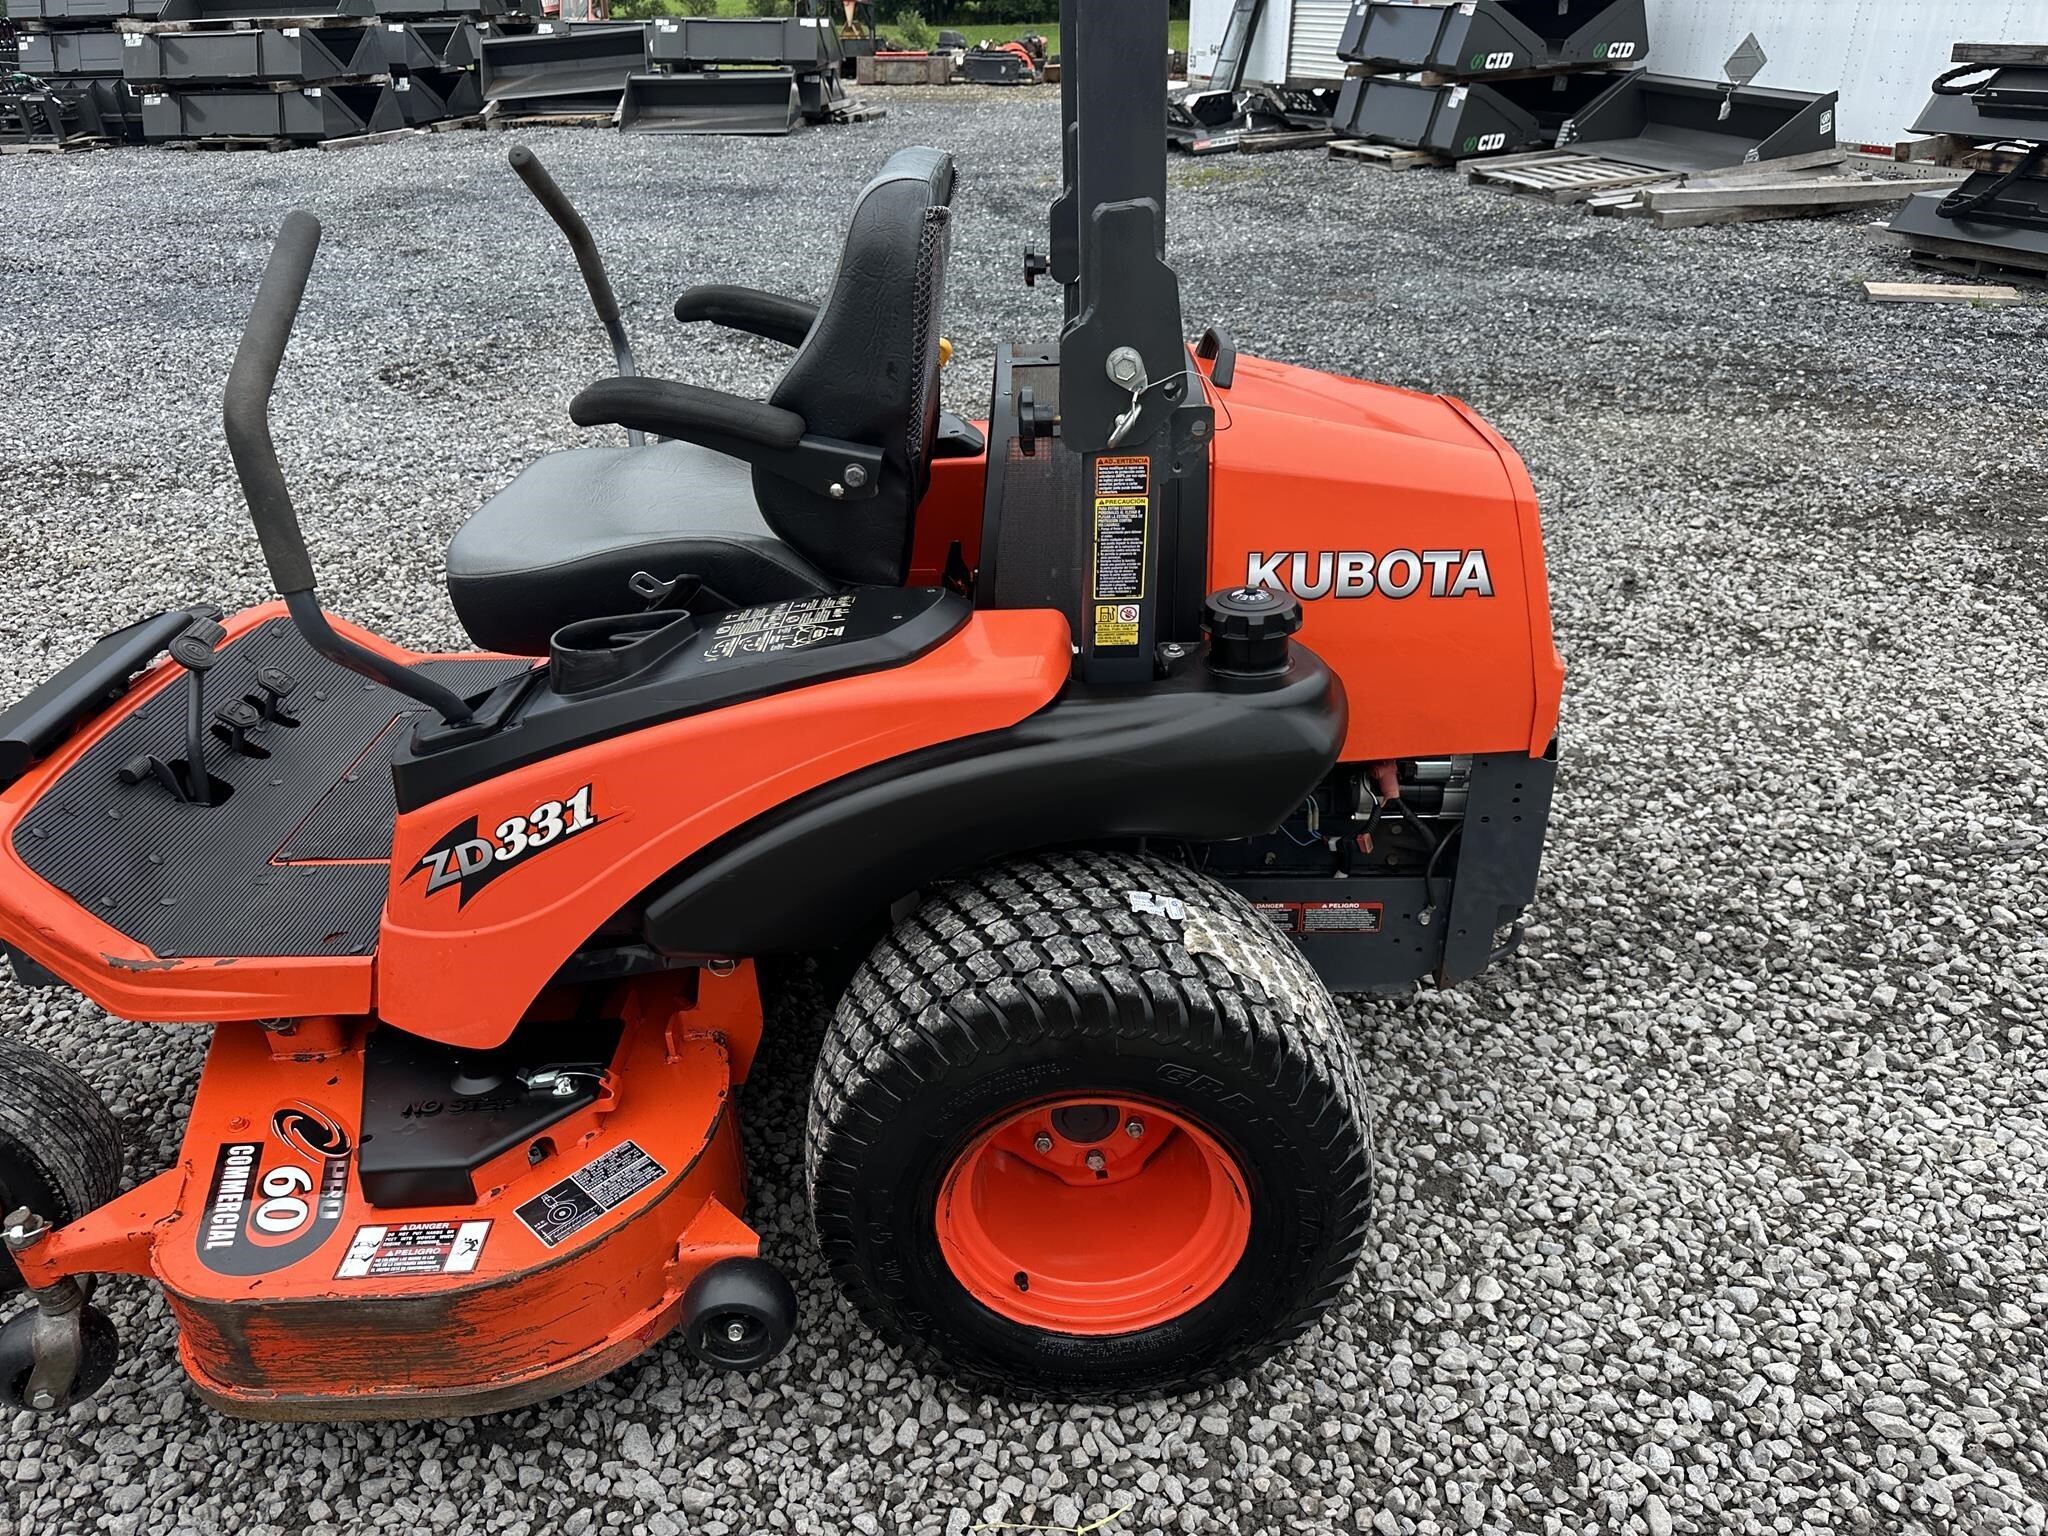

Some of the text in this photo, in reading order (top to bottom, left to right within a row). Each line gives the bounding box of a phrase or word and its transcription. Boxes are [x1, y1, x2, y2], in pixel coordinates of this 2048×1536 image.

[1484, 52, 1514, 69] CID
[1607, 42, 1635, 58] CID
[1477, 133, 1506, 151] CID
[1246, 549, 1495, 600] KUBOTA
[422, 784, 598, 898] ZD331
[401, 1095, 515, 1118] NO STEP
[205, 1144, 255, 1250] COMMERCIAL
[253, 1165, 313, 1235] 60
[394, 1248, 441, 1256] PELIGRO
